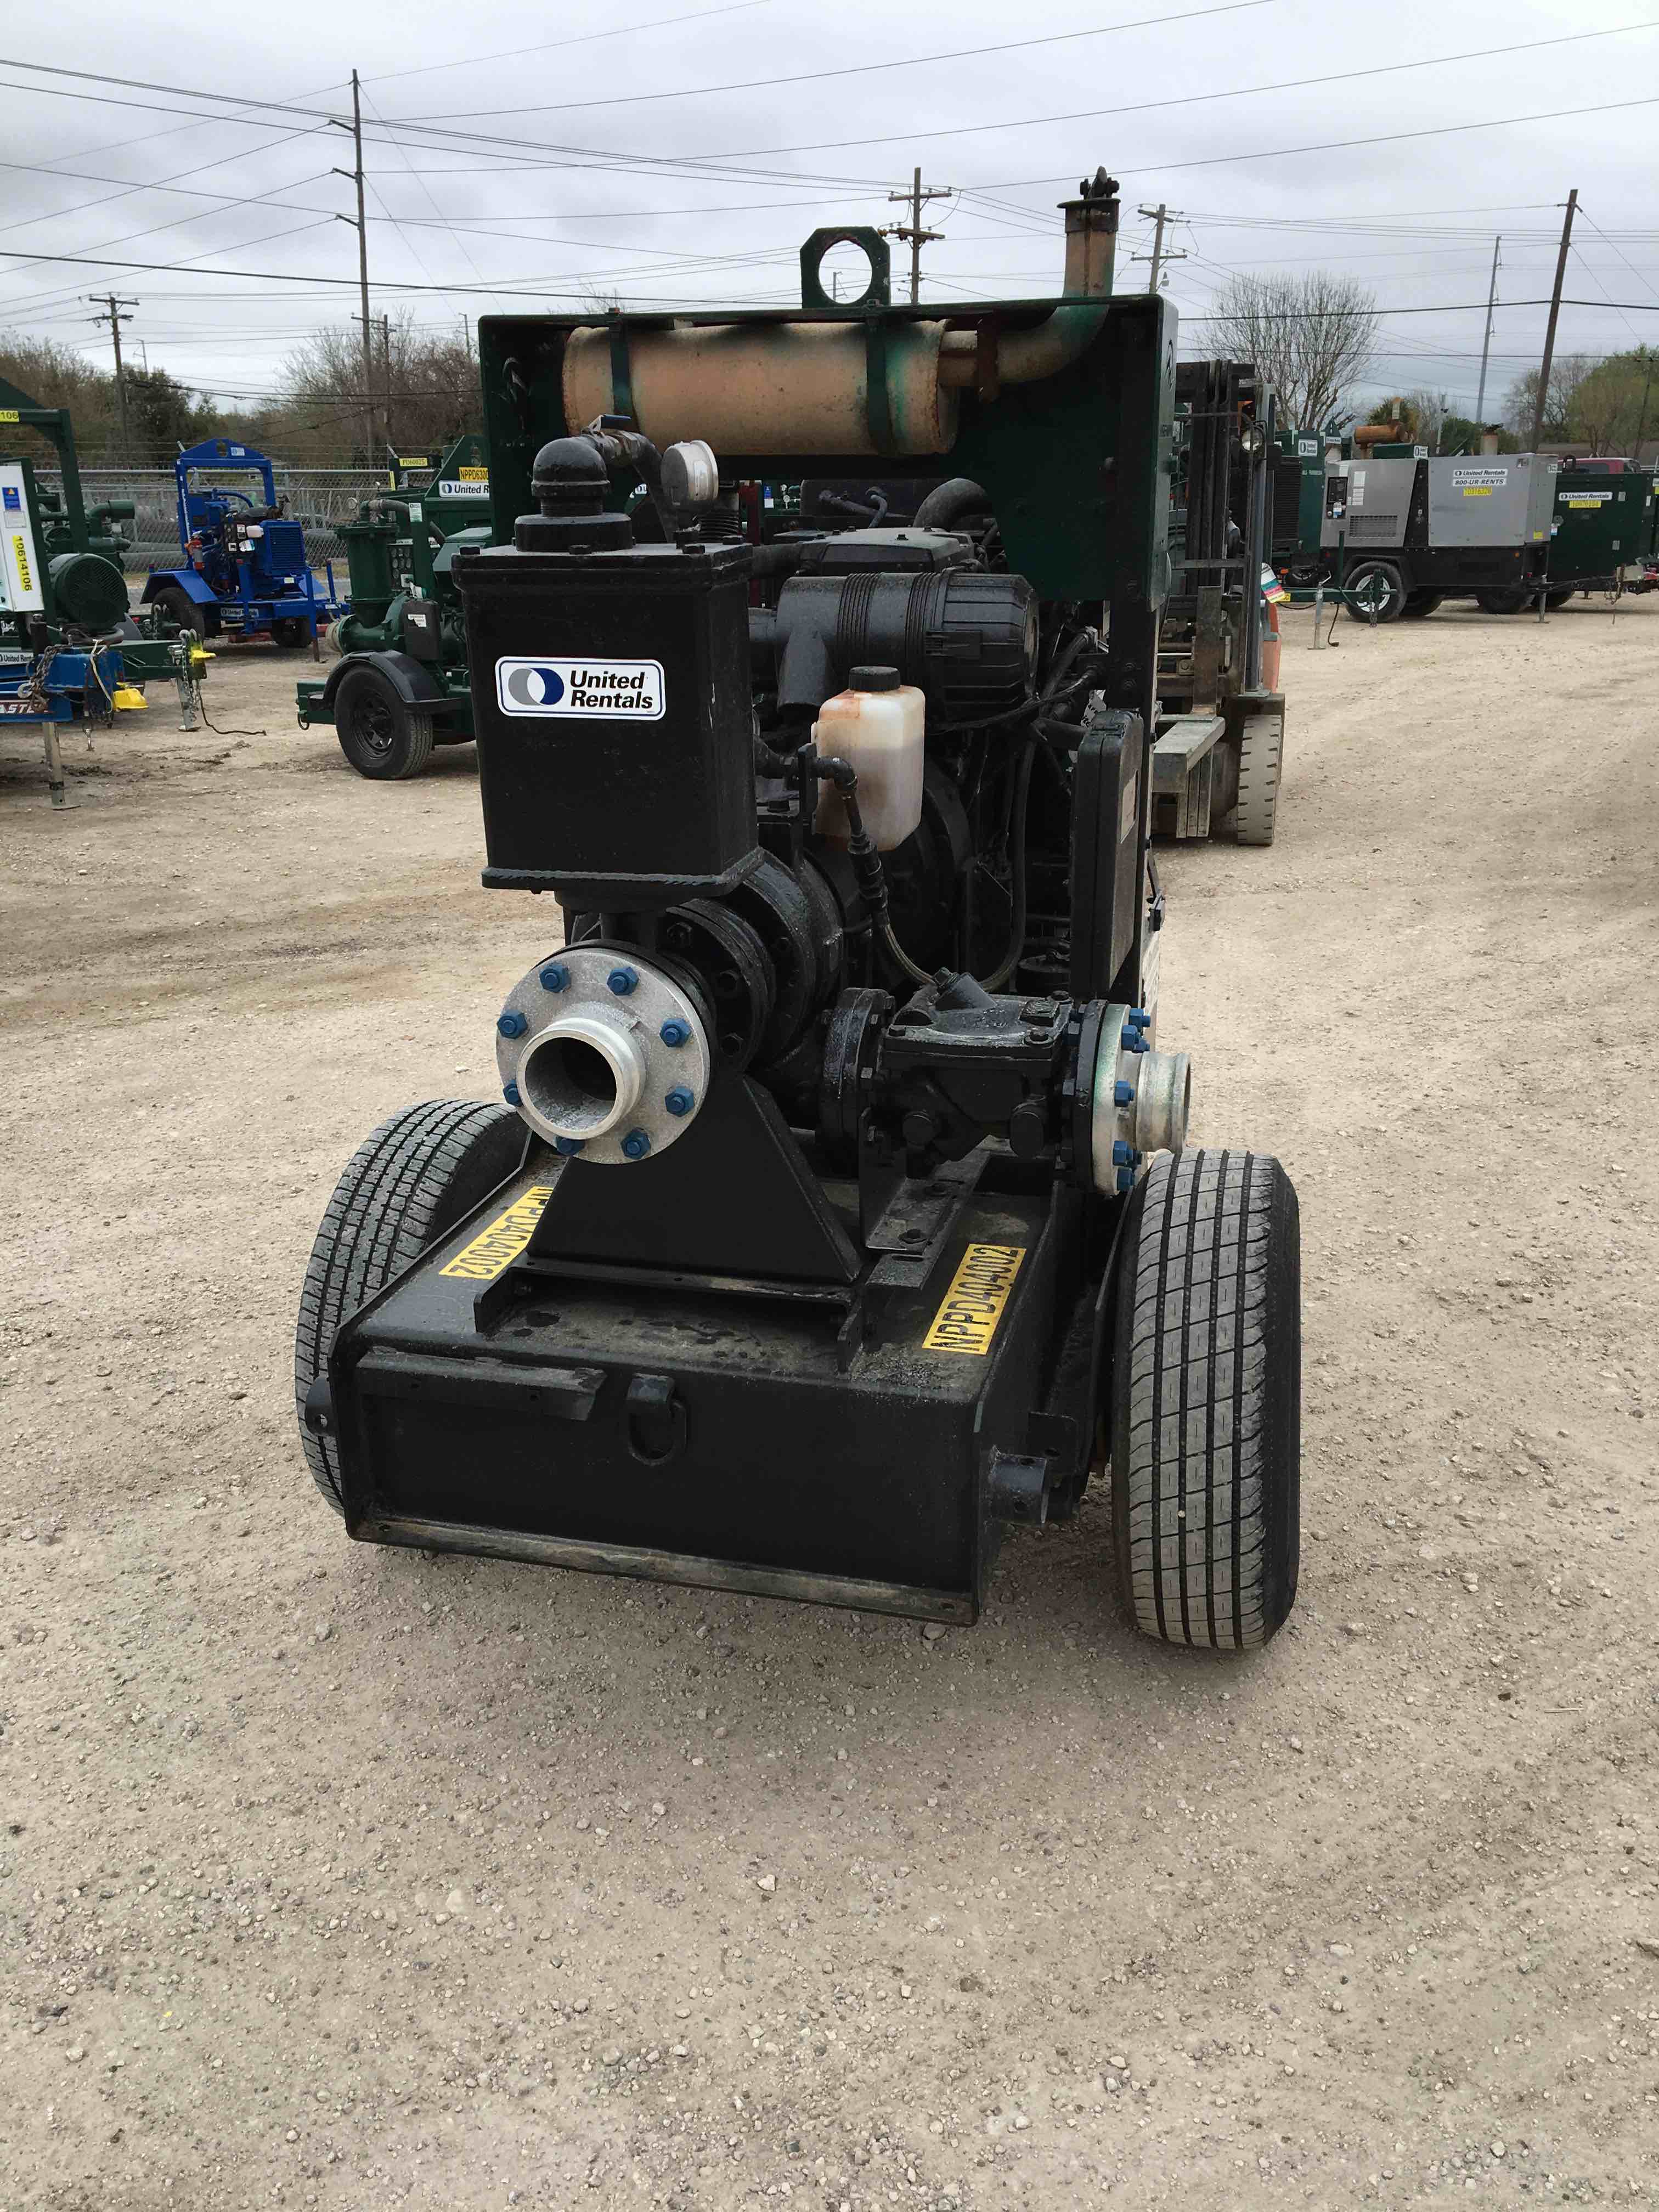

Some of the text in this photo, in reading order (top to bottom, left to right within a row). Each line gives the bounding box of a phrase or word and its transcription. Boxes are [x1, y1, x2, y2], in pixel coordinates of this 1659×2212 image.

[454, 484, 481, 494] United
[15, 535, 32, 591] 10614106
[4, 653, 19, 662] United
[570, 670, 645, 690] United
[570, 689, 653, 709] Rentals
[930, 1246, 1019, 1352] NPPD404002
